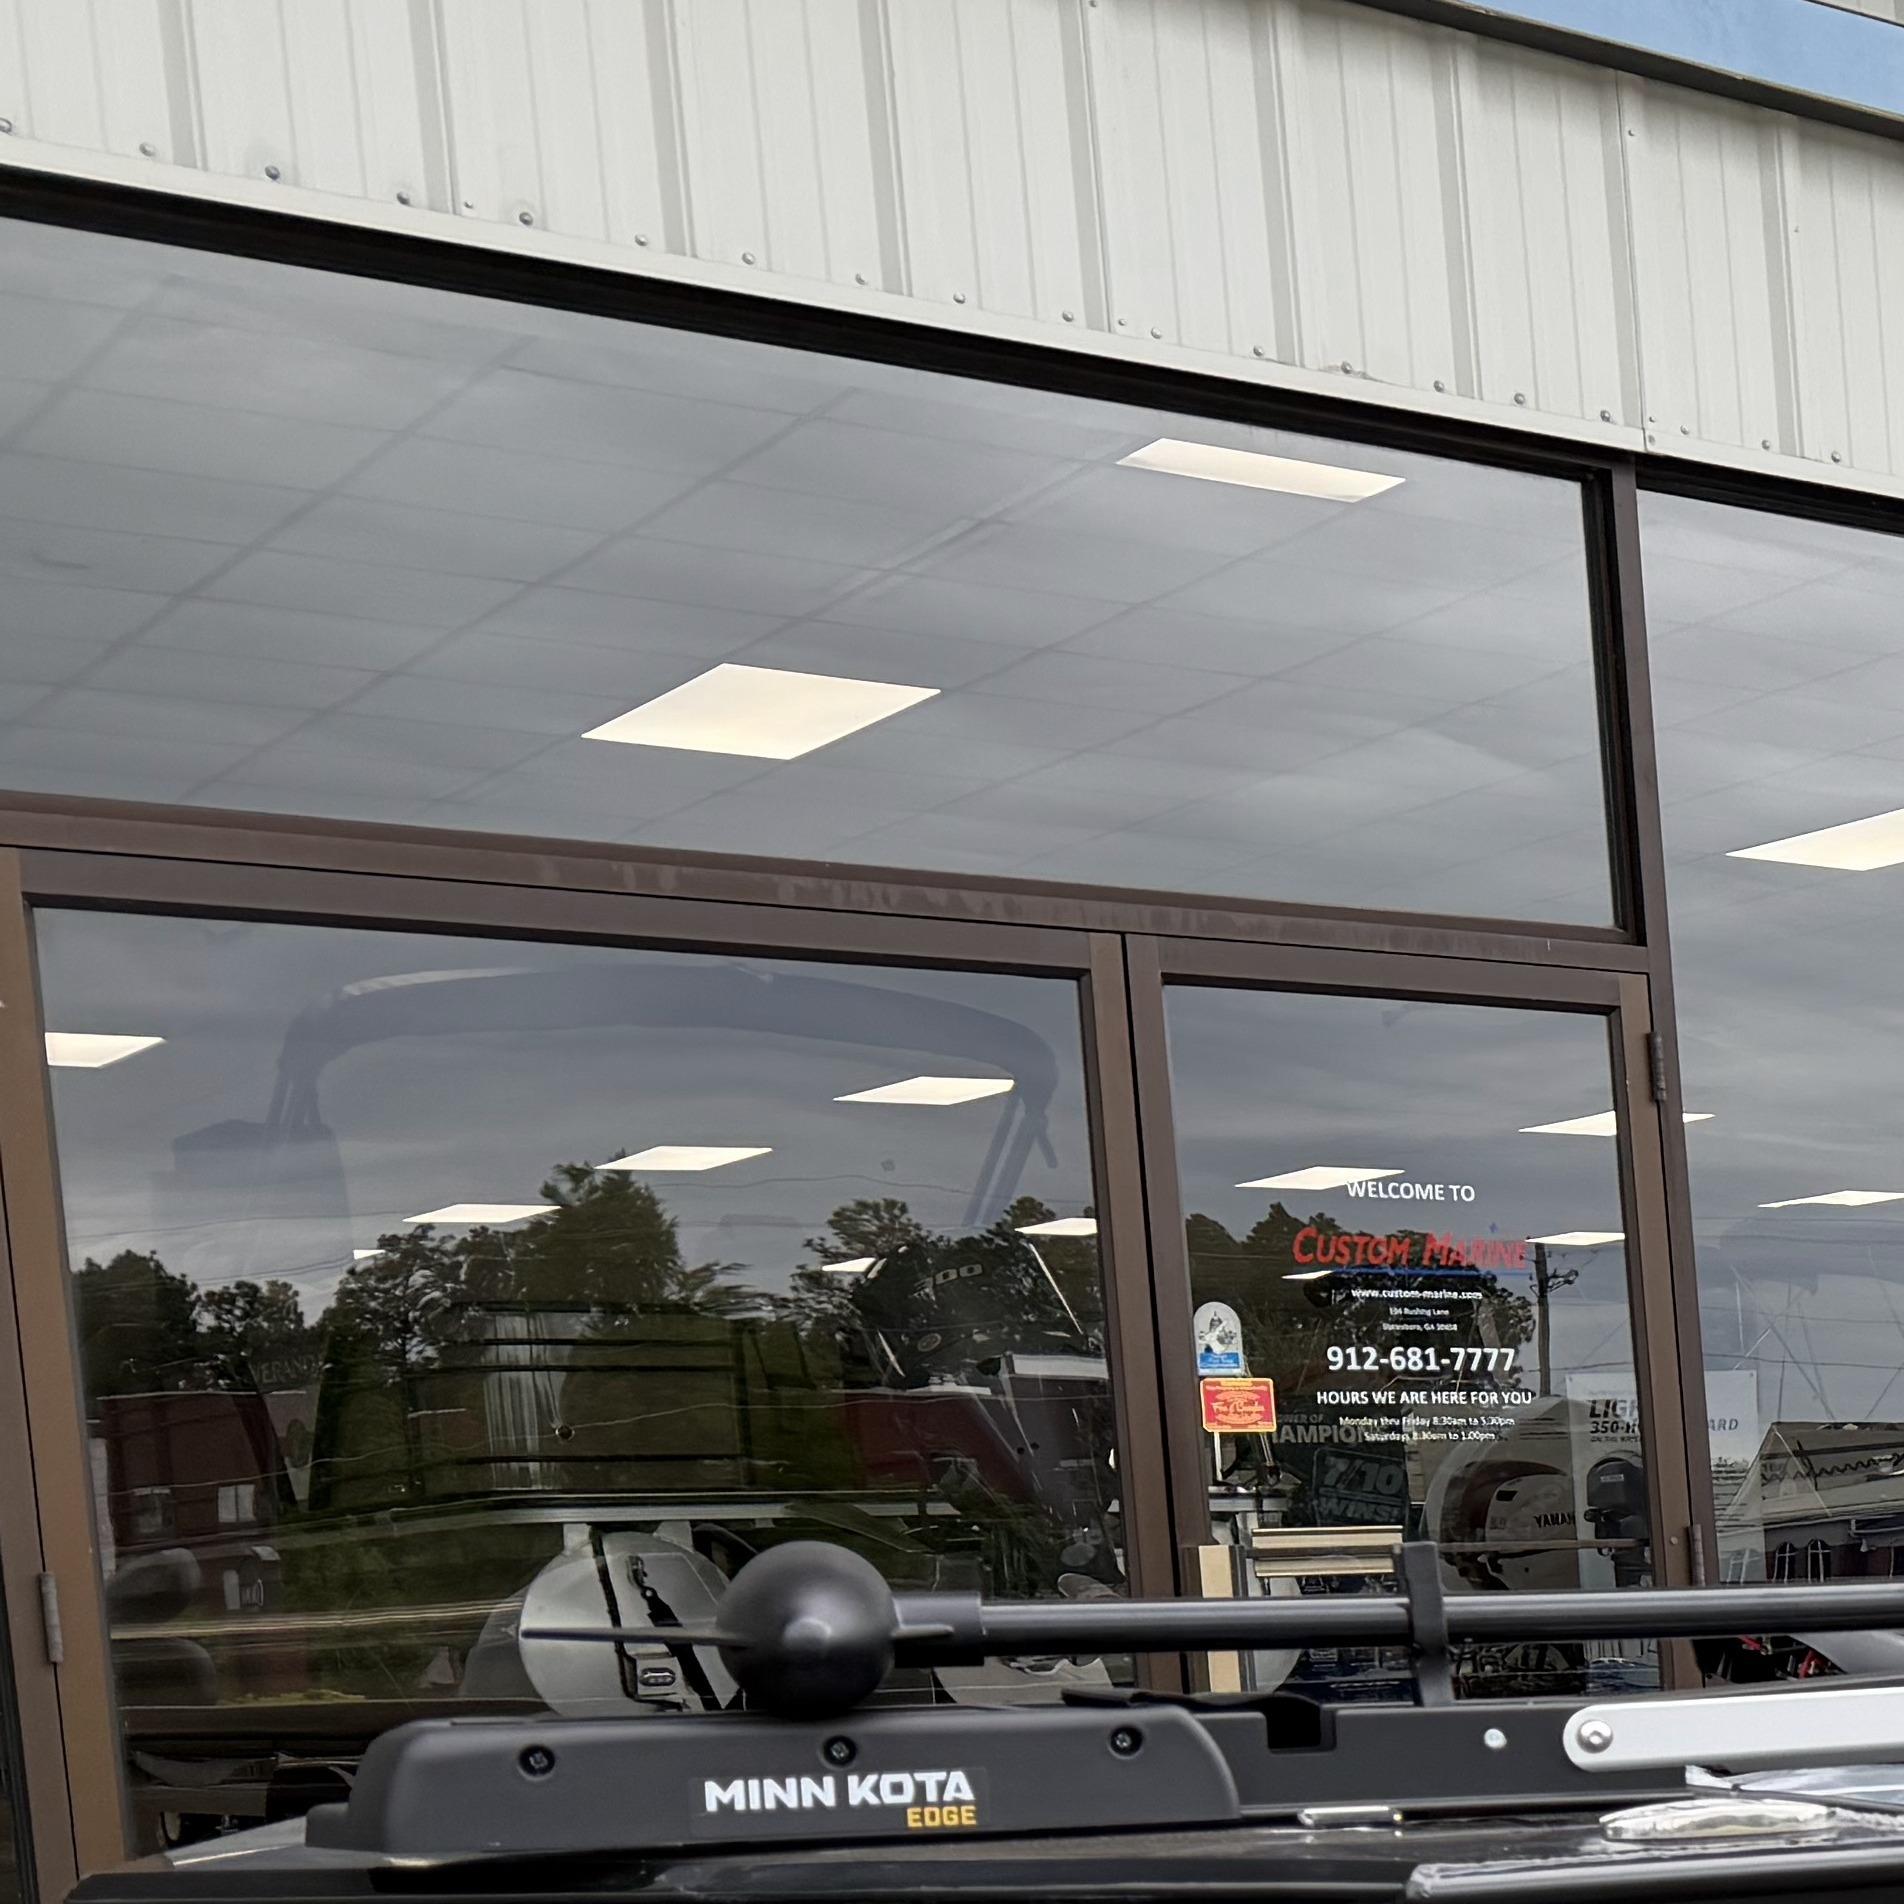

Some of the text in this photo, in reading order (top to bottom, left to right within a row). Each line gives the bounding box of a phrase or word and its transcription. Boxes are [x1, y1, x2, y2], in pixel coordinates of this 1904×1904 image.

[1347, 1181, 1475, 1202] WELCOME TO
[1292, 1226, 1527, 1269] CUSTOM MARINE
[1326, 1345, 1515, 1372] 912-681-7777
[1316, 1390, 1532, 1405] HOURS WE ARE HERE FOR YOU
[1339, 1416, 1378, 1427] Monday
[1469, 1417, 1479, 1426] to
[1448, 1431, 1459, 1440] to
[704, 1770, 976, 1813] MINN KOTA
[906, 1804, 978, 1828] EDGE
